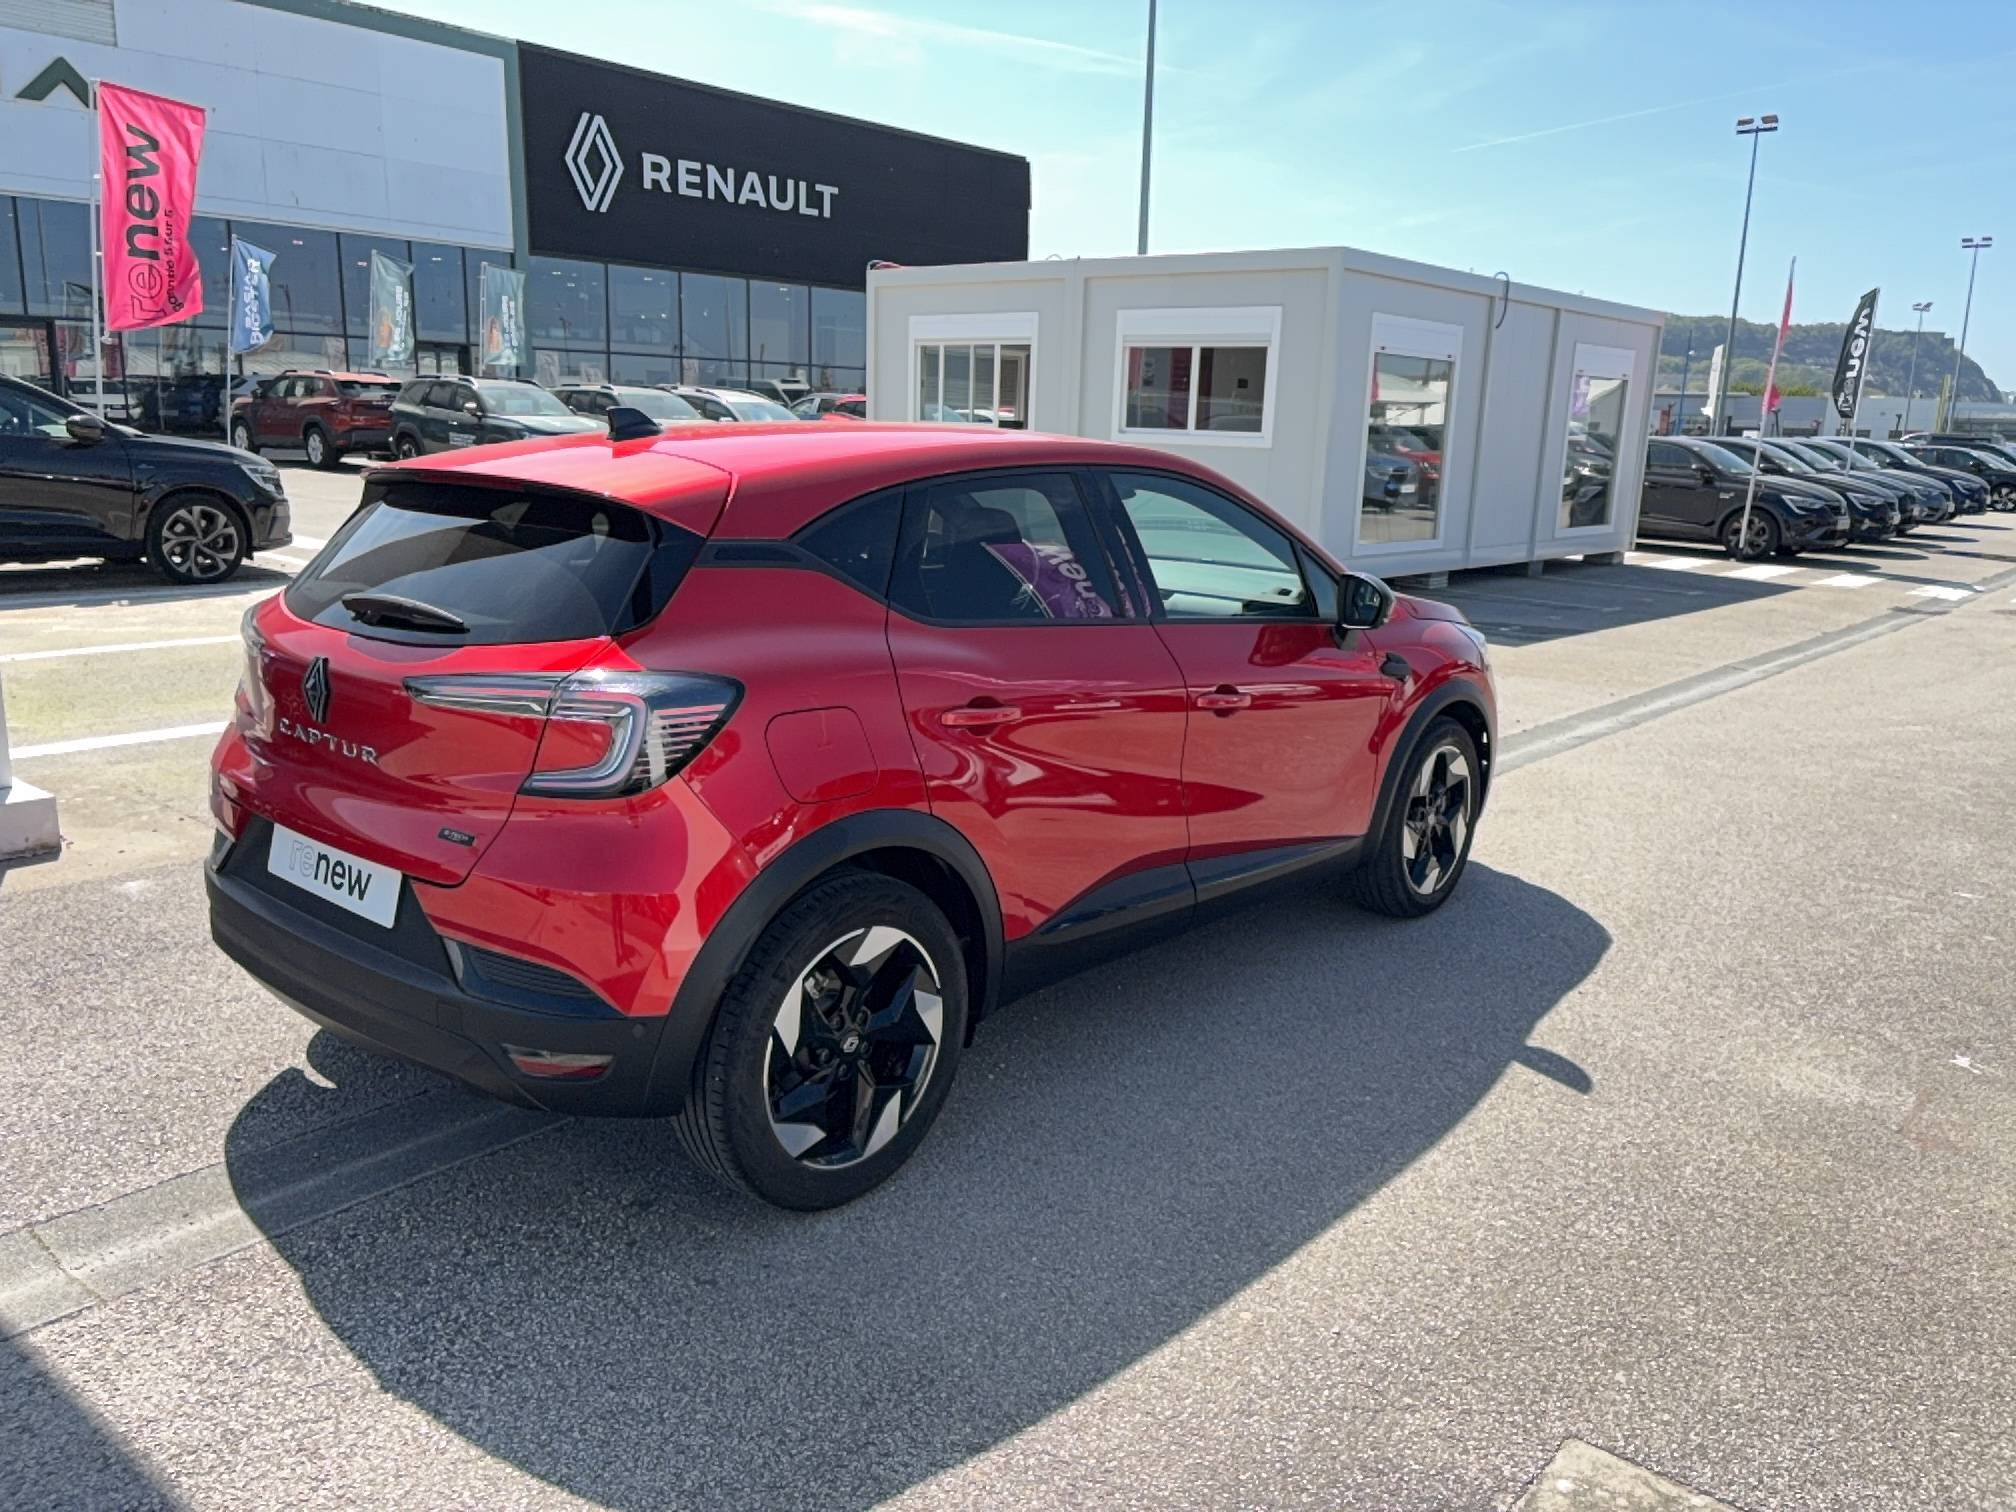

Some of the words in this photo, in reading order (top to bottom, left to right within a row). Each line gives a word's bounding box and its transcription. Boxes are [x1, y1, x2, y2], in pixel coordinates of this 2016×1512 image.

[642, 152, 839, 218] RENAULT
[126, 122, 167, 320] renew
[279, 717, 379, 765] CAPTUR
[288, 839, 373, 901] renew
